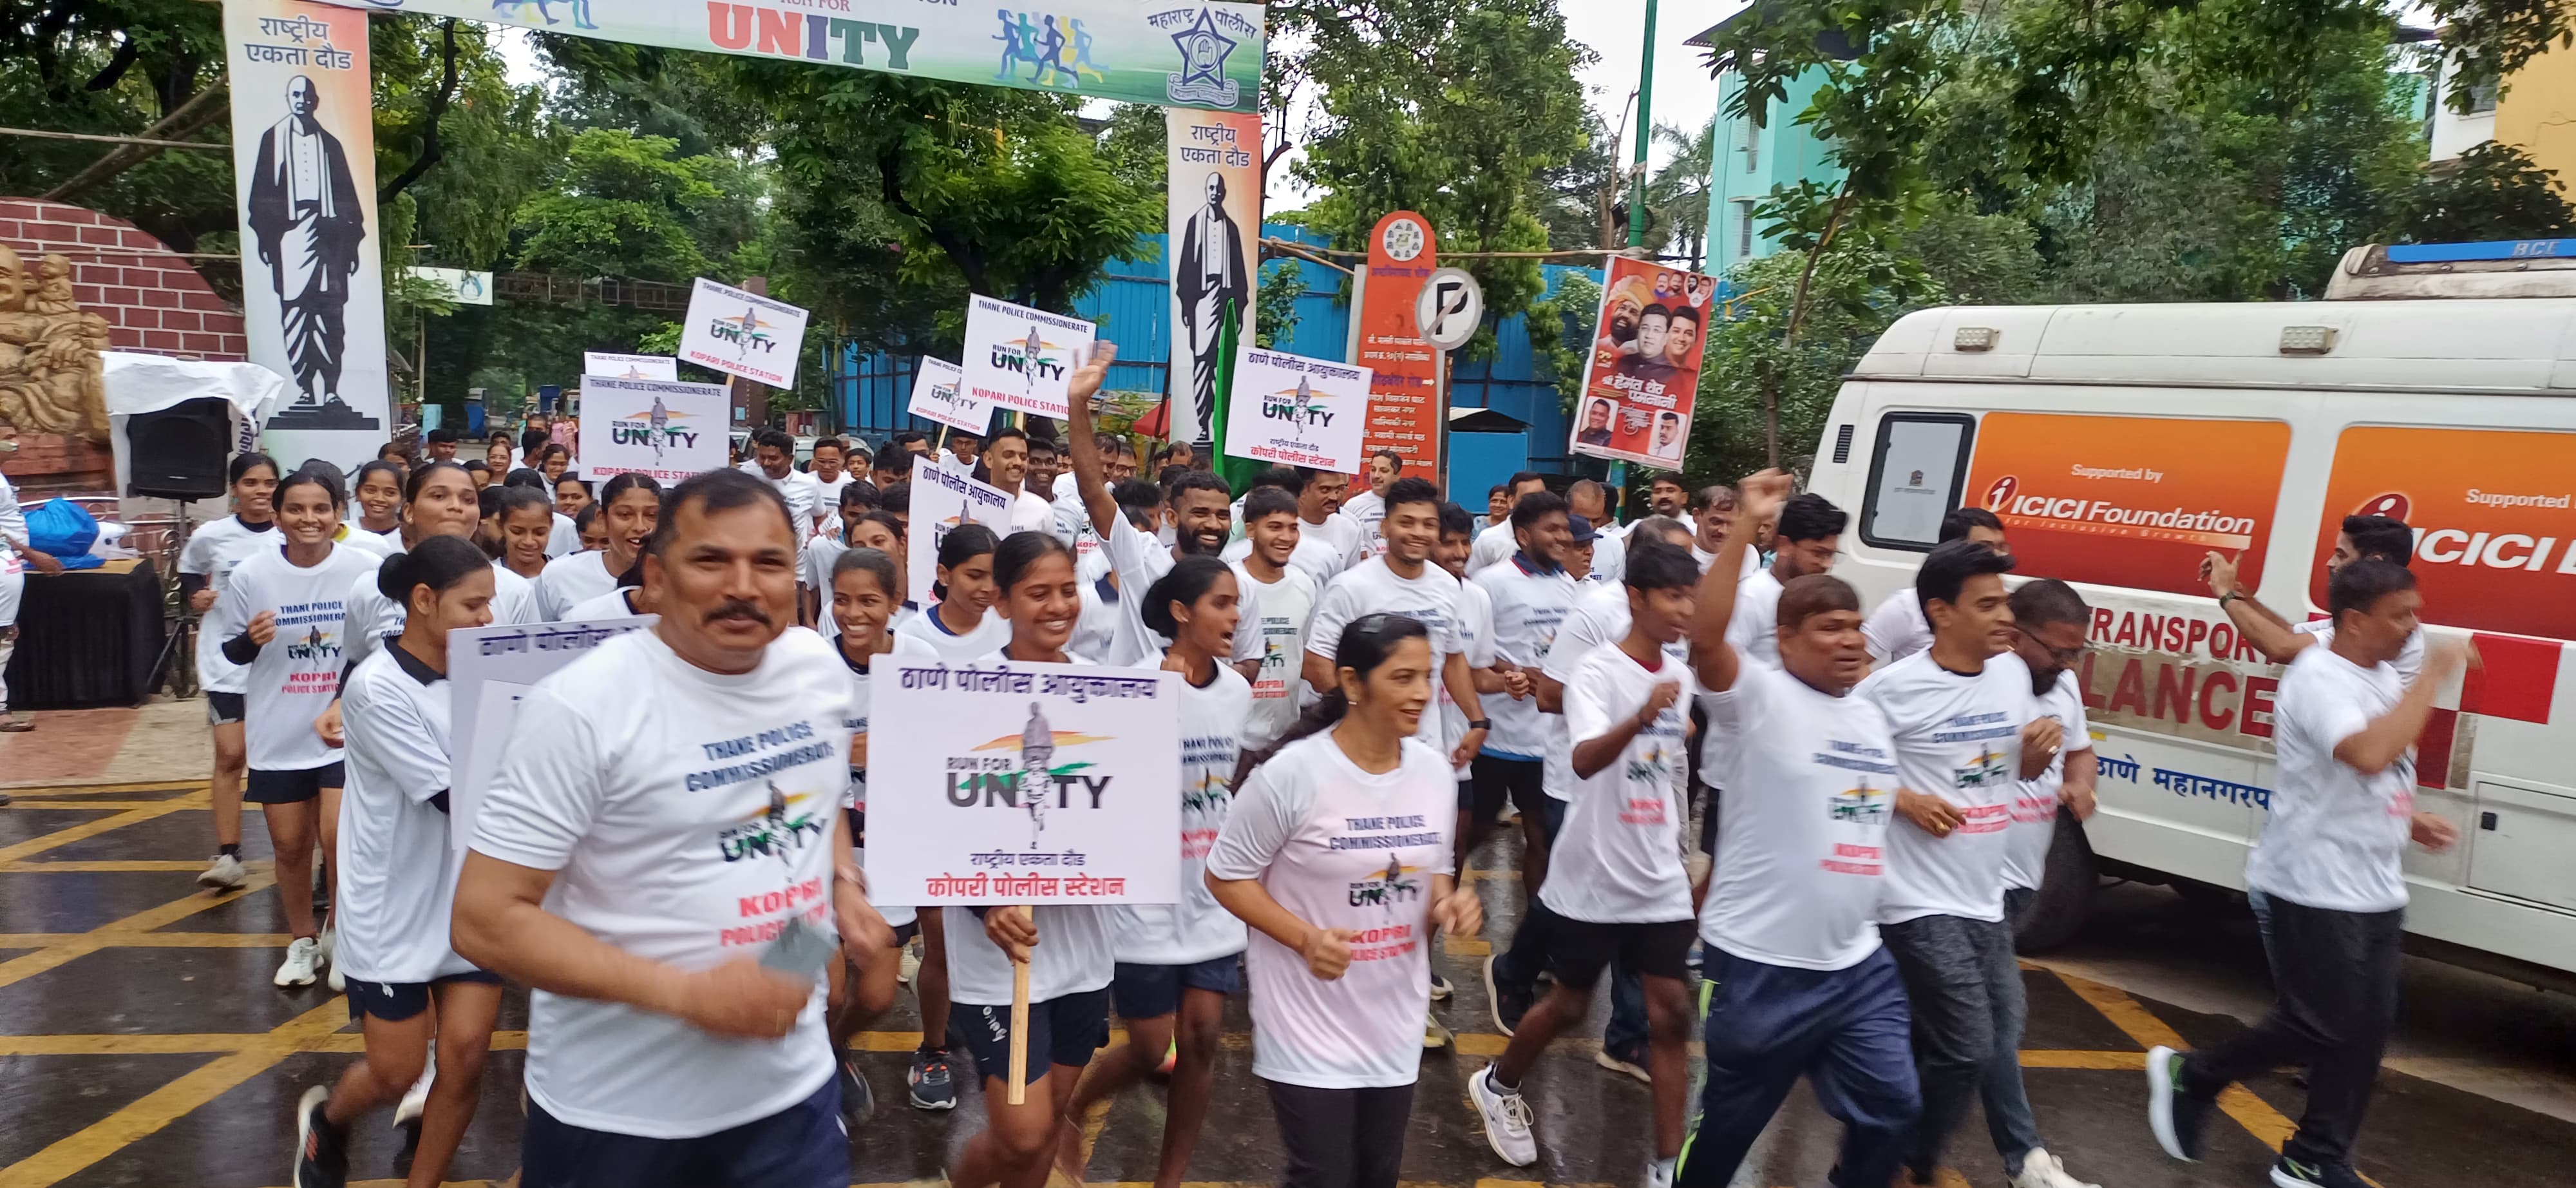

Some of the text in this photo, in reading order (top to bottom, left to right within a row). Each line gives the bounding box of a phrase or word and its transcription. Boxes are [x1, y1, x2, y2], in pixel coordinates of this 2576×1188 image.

[258, 15, 329, 43] राष्ट्रीय
[707, 1, 920, 70] UNITY
[1147, 8, 1258, 39] महाराष्ट्र पोलीस
[243, 43, 352, 70] एकता दौड
[1191, 122, 1236, 146] राष्ट्रीय
[1180, 146, 1250, 166] एकता दौड
[978, 300, 1088, 333] THANE POLICE COMMISSIONERATE
[992, 344, 1021, 356] RUN FOR
[1248, 352, 1270, 365] ठाणे
[1272, 355, 1306, 372] पोलीस
[721, 359, 748, 373] POLICE
[750, 367, 783, 383] STATION
[618, 381, 645, 391] POLICE
[972, 387, 1069, 416] KOPARI POLICE STATIO
[1250, 445, 1336, 468] कोपरी पोलीस स्टेशन
[2071, 463, 2164, 483] Supported by
[923, 465, 1007, 510] ठाणे पोलीस आयुक्तालय
[2466, 488, 2571, 509] Supported
[2011, 495, 2088, 521] ICICI
[2087, 501, 2255, 535] Foundation
[312, 600, 343, 612] POLICE
[282, 685, 310, 694] POLICE
[900, 662, 949, 690] ठाणे
[955, 664, 1036, 694] पोलीस
[947, 757, 1012, 771] RUN FOR
[971, 849, 1086, 869] राष्ट्रीय एकता दौड
[926, 872, 1126, 898] कोपरी पोलीस स्टेशन
